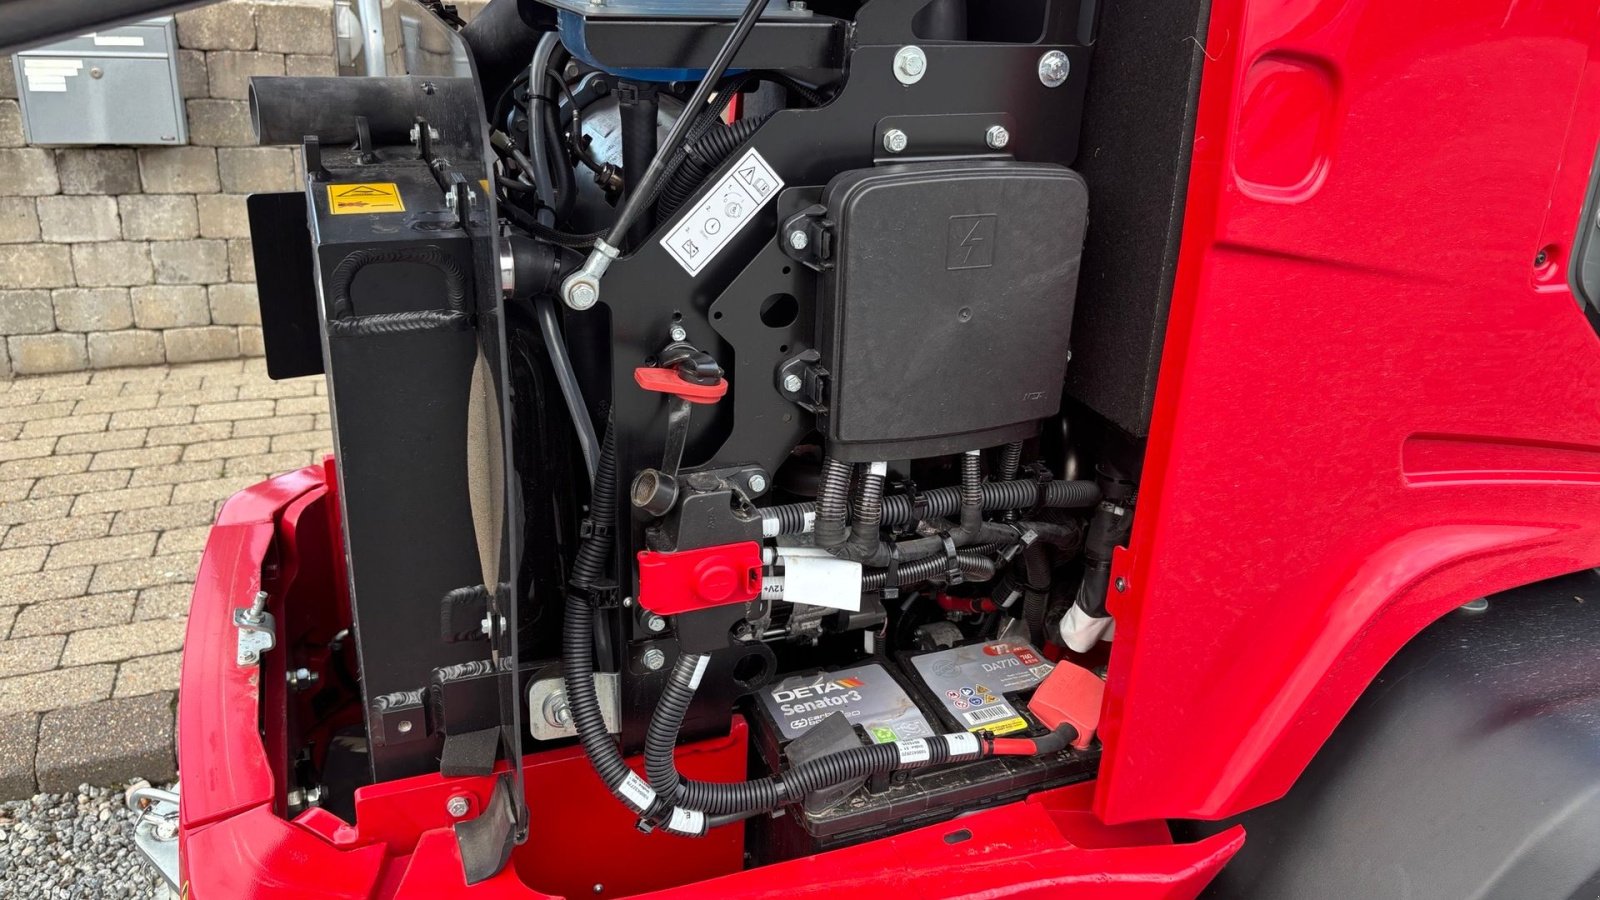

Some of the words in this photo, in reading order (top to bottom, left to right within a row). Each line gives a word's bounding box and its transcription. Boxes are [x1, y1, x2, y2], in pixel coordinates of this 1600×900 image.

[763, 585, 784, 593] 12V+
[981, 658, 1020, 672] DA770
[772, 682, 845, 703] DETA
